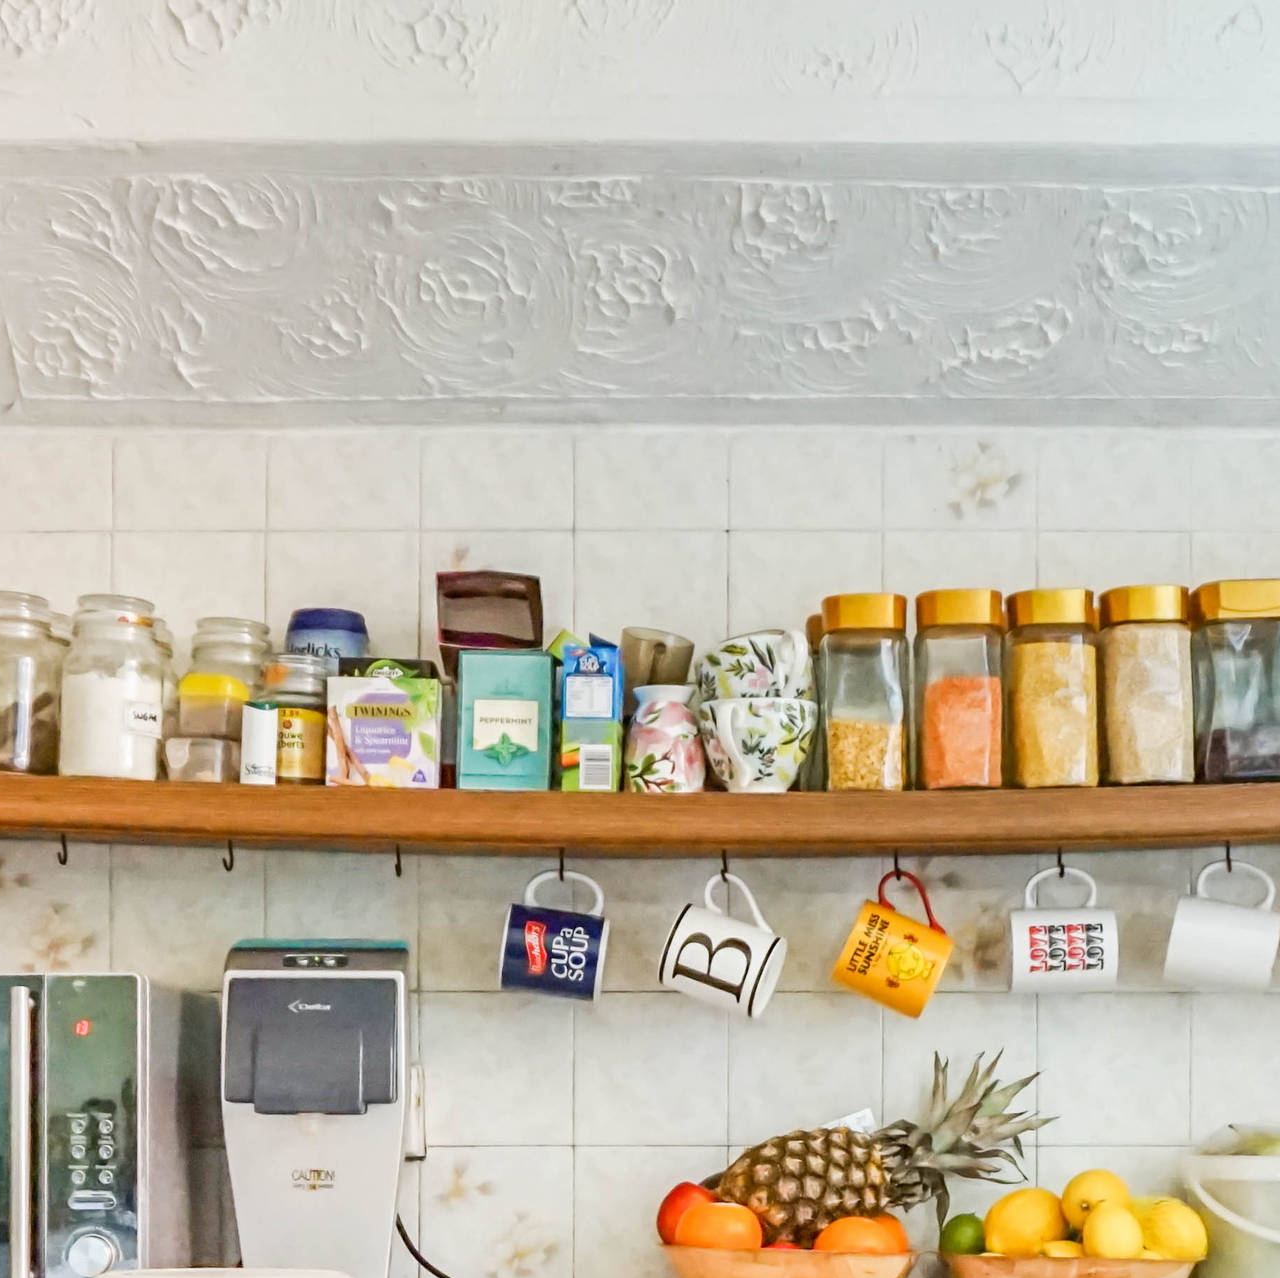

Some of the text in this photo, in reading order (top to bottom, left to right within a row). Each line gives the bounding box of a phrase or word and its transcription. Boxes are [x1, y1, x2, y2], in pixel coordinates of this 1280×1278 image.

[352, 705, 412, 717] TWININGS
[479, 716, 533, 725] PEPPERMINT
[278, 731, 303, 740] ouwe
[567, 926, 590, 982] SOUP
[846, 939, 868, 973] LITTLE
[864, 913, 880, 938] MISS
[857, 918, 890, 976] SUNSHINE
[1029, 925, 1048, 973] LOVE
[1048, 925, 1067, 972] LOVE
[1066, 924, 1086, 971] LOVE
[1085, 923, 1104, 971] LOVE
[672, 931, 752, 1004] B
